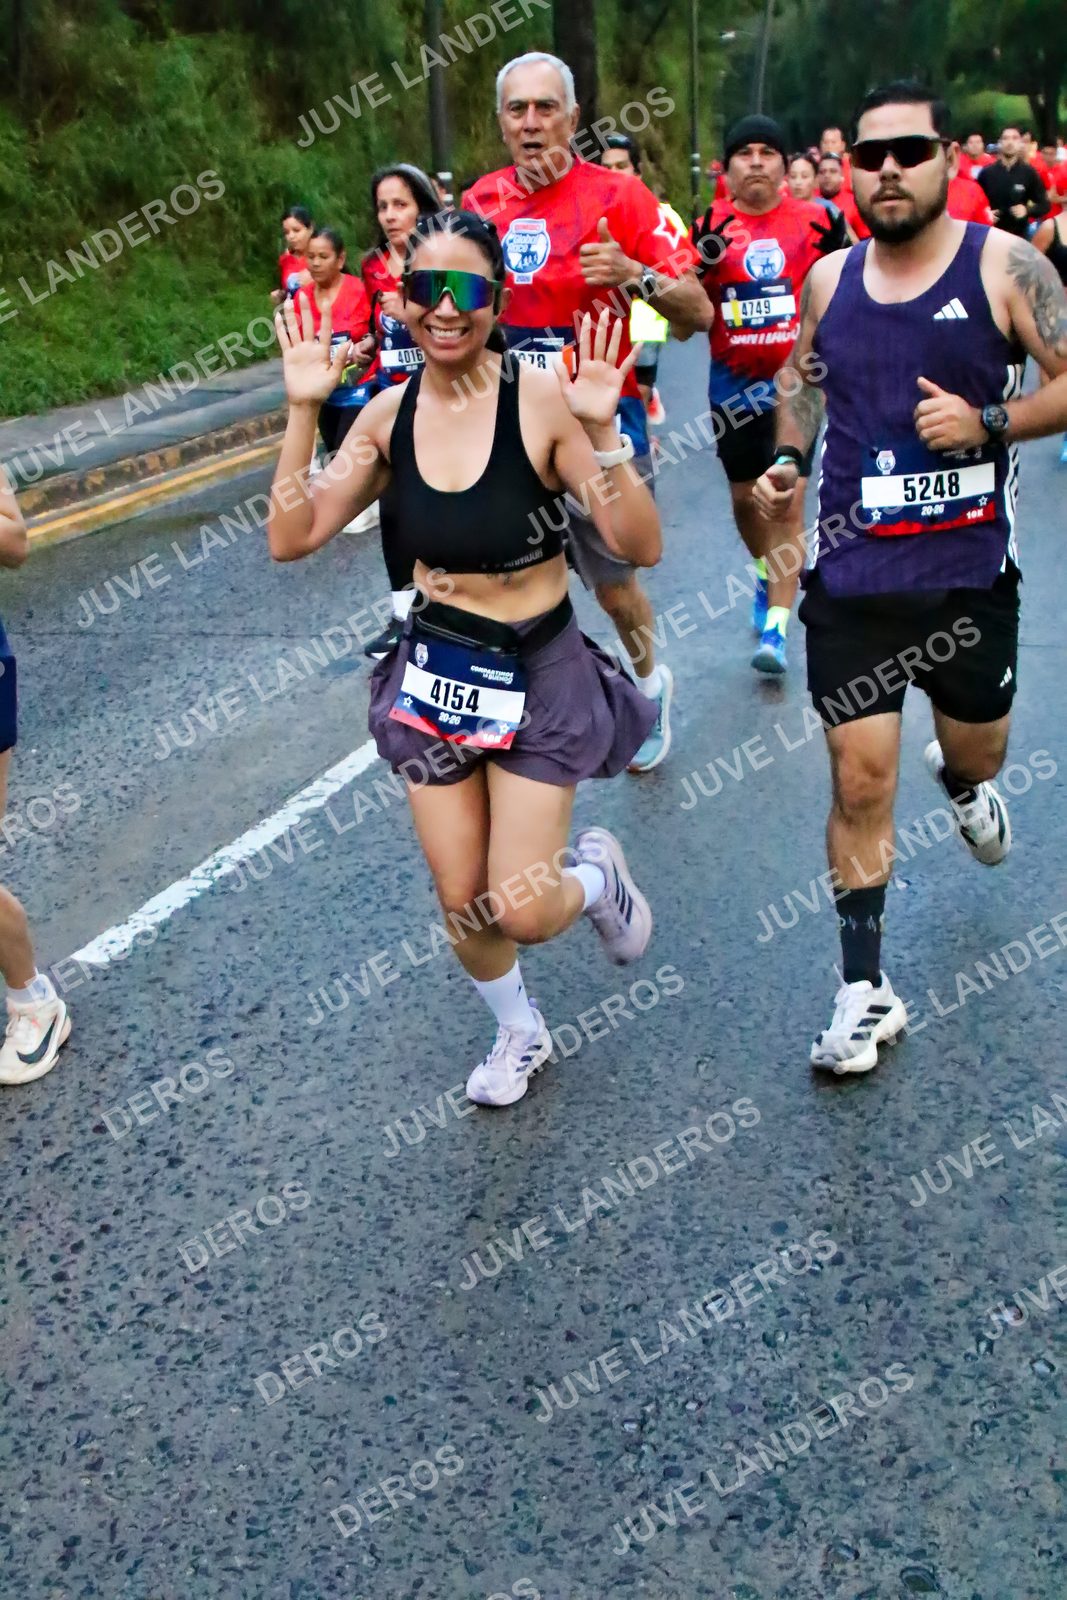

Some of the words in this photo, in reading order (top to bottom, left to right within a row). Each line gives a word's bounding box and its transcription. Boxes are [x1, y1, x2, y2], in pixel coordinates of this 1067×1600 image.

[742, 299, 771, 316] 4749
[398, 348, 423, 364] 4016
[903, 472, 960, 502] 5248
[920, 503, 945, 516] 20-26
[966, 508, 984, 520] 10K
[430, 678, 480, 713] 4154
[438, 711, 462, 725] 20-26
